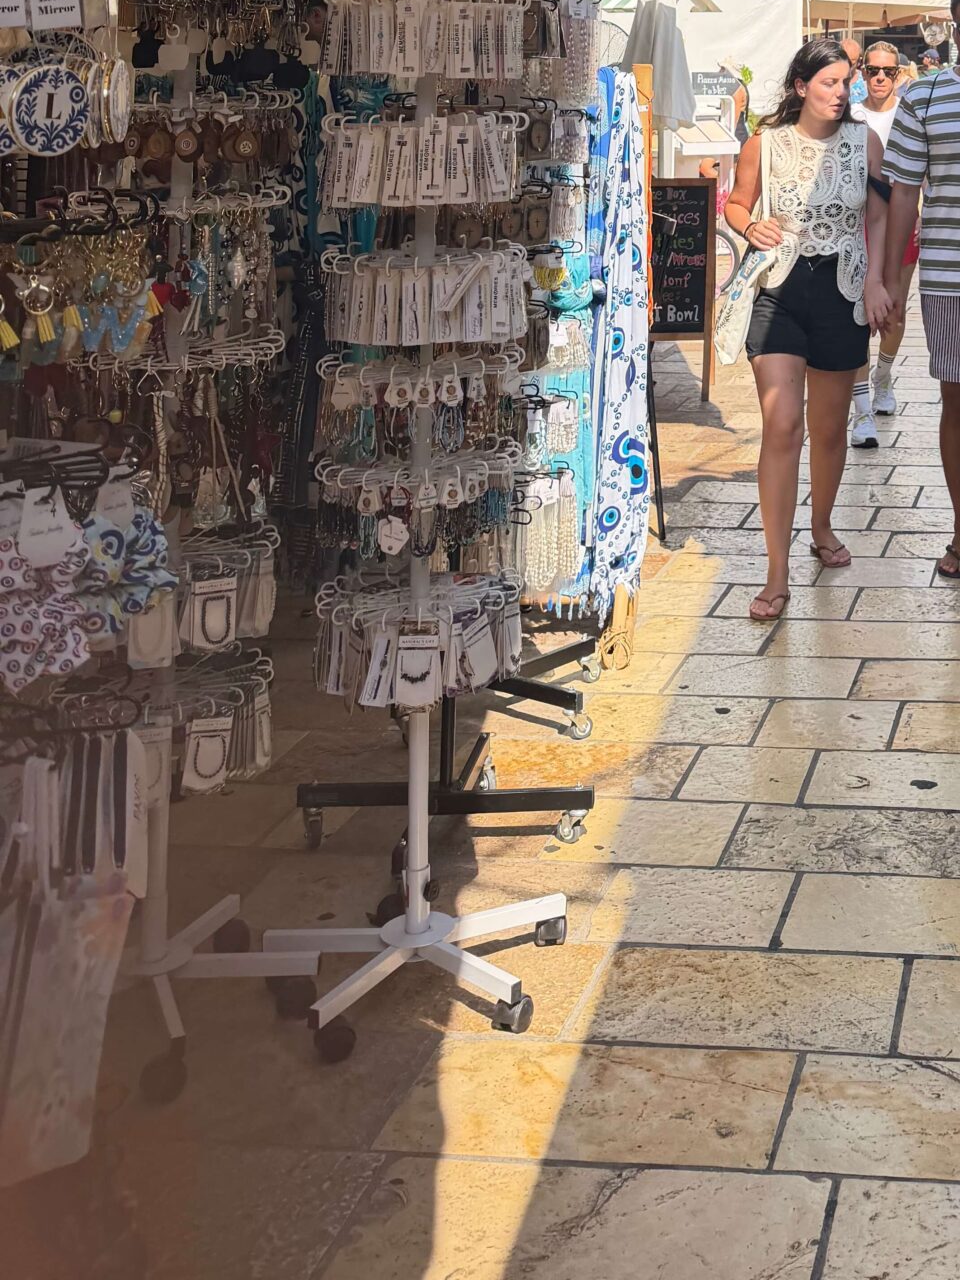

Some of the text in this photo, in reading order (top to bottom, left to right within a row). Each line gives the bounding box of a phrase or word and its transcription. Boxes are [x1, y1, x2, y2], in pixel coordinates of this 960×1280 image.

[38, 4, 76, 16] Mirror
[335, 151, 344, 183] MEMORIES
[386, 149, 395, 181] MEMORIES
[423, 138, 431, 171] MEMORIES
[666, 304, 699, 322] Bowl
